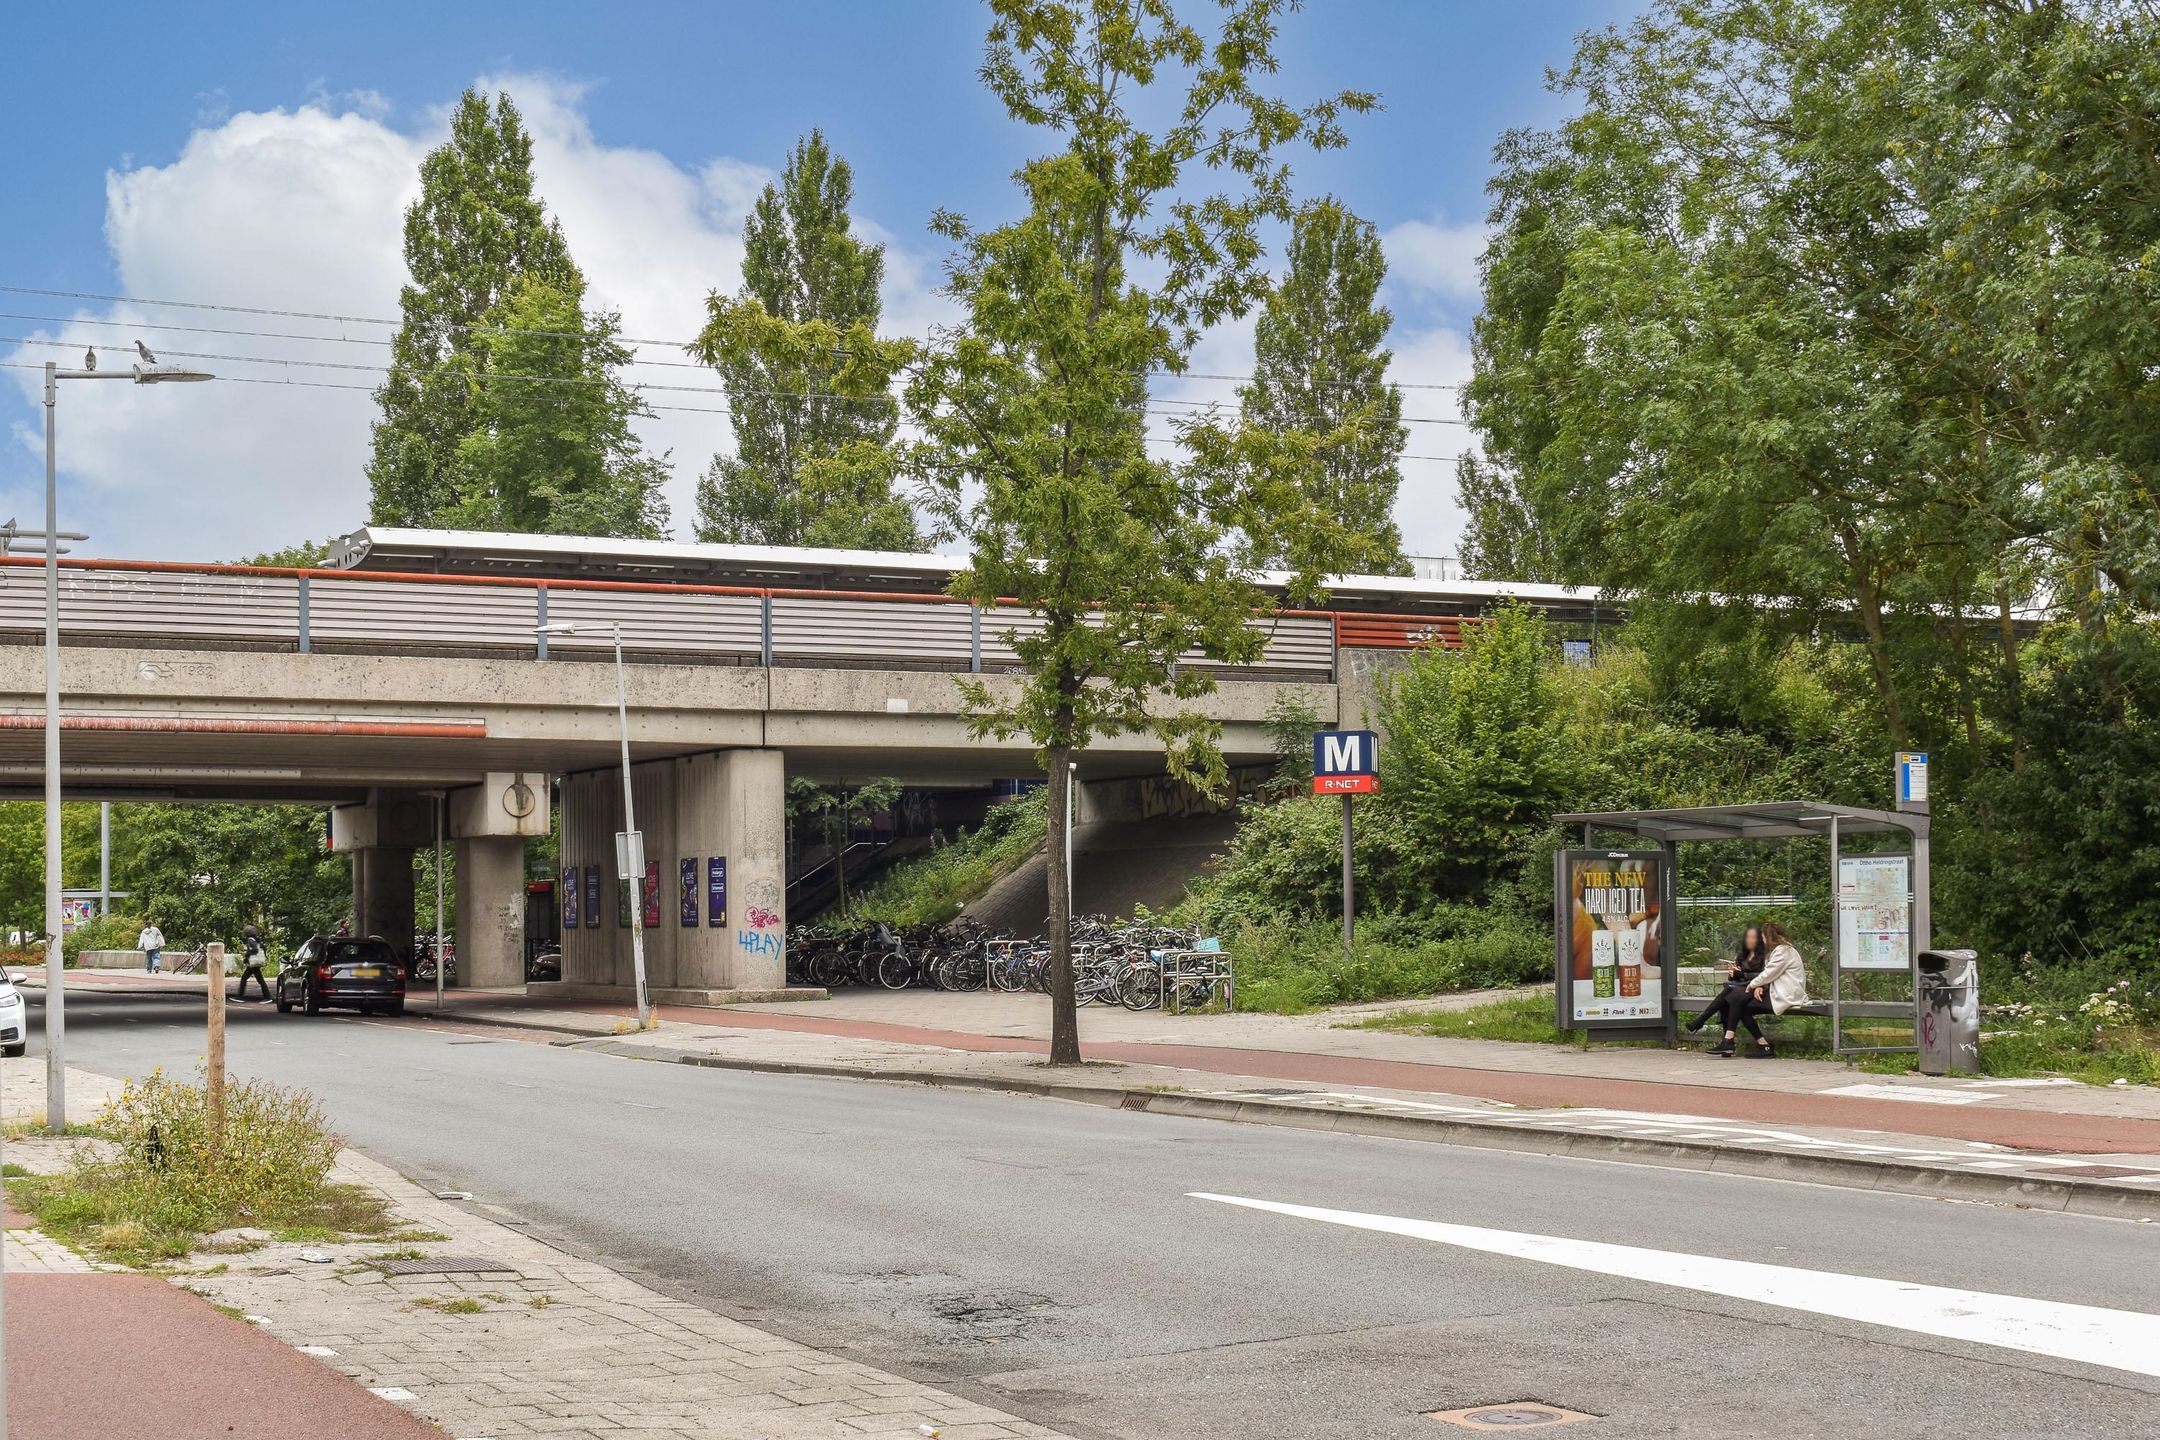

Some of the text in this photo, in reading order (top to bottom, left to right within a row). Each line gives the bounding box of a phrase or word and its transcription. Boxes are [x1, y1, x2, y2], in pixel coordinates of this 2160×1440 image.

[182, 665, 213, 676] 1982
[1324, 735, 1360, 772] M
[1584, 871, 1646, 887] THE NEW
[1585, 888, 1646, 914] HARD ICED TEA
[739, 931, 782, 960] 4PLAY
